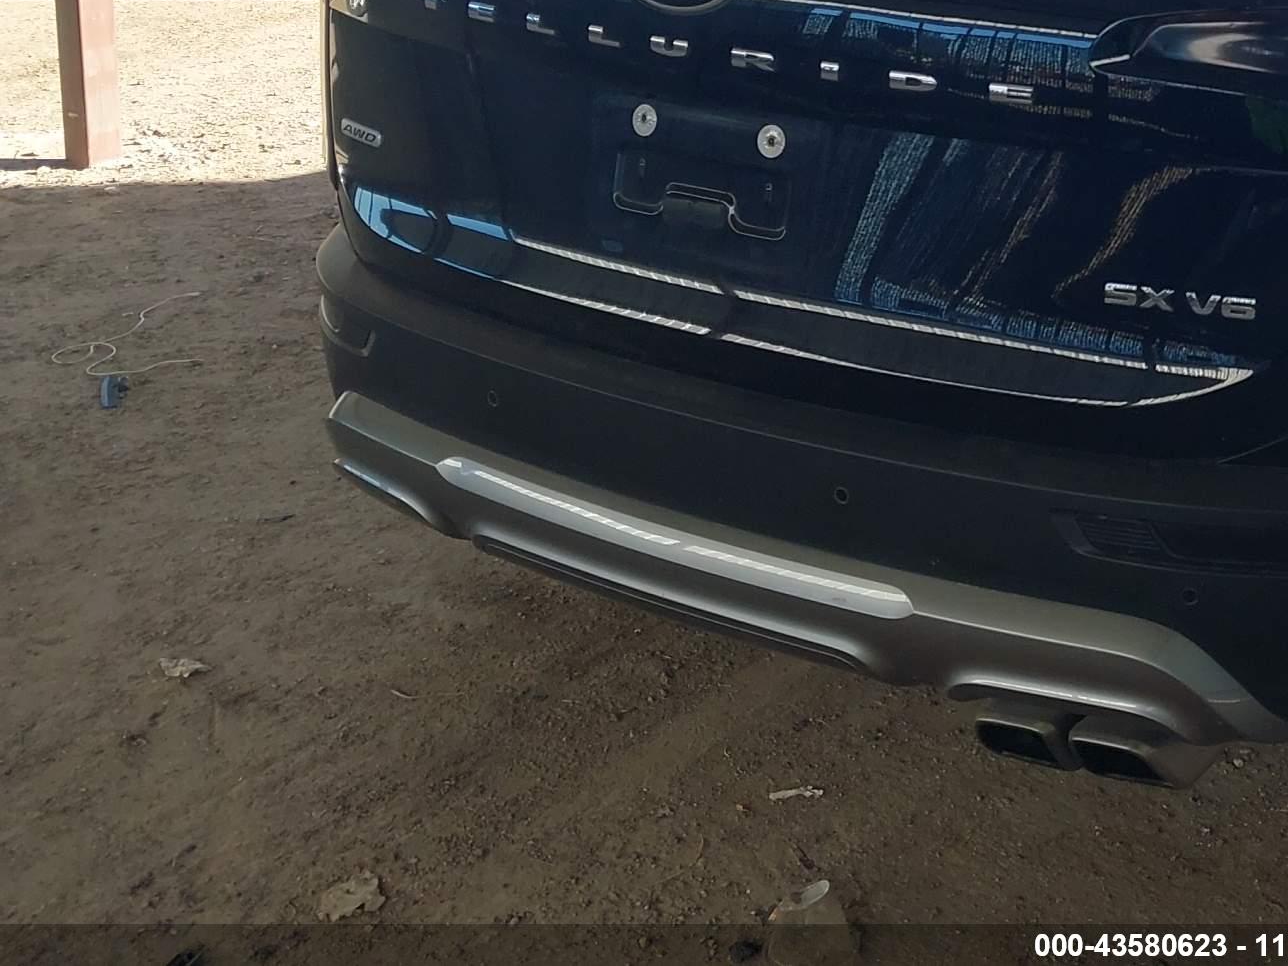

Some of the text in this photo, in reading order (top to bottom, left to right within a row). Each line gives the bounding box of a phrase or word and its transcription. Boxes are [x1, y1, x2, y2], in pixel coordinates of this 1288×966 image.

[343, 124, 377, 143] AWD
[1104, 282, 1257, 321] SX V6
